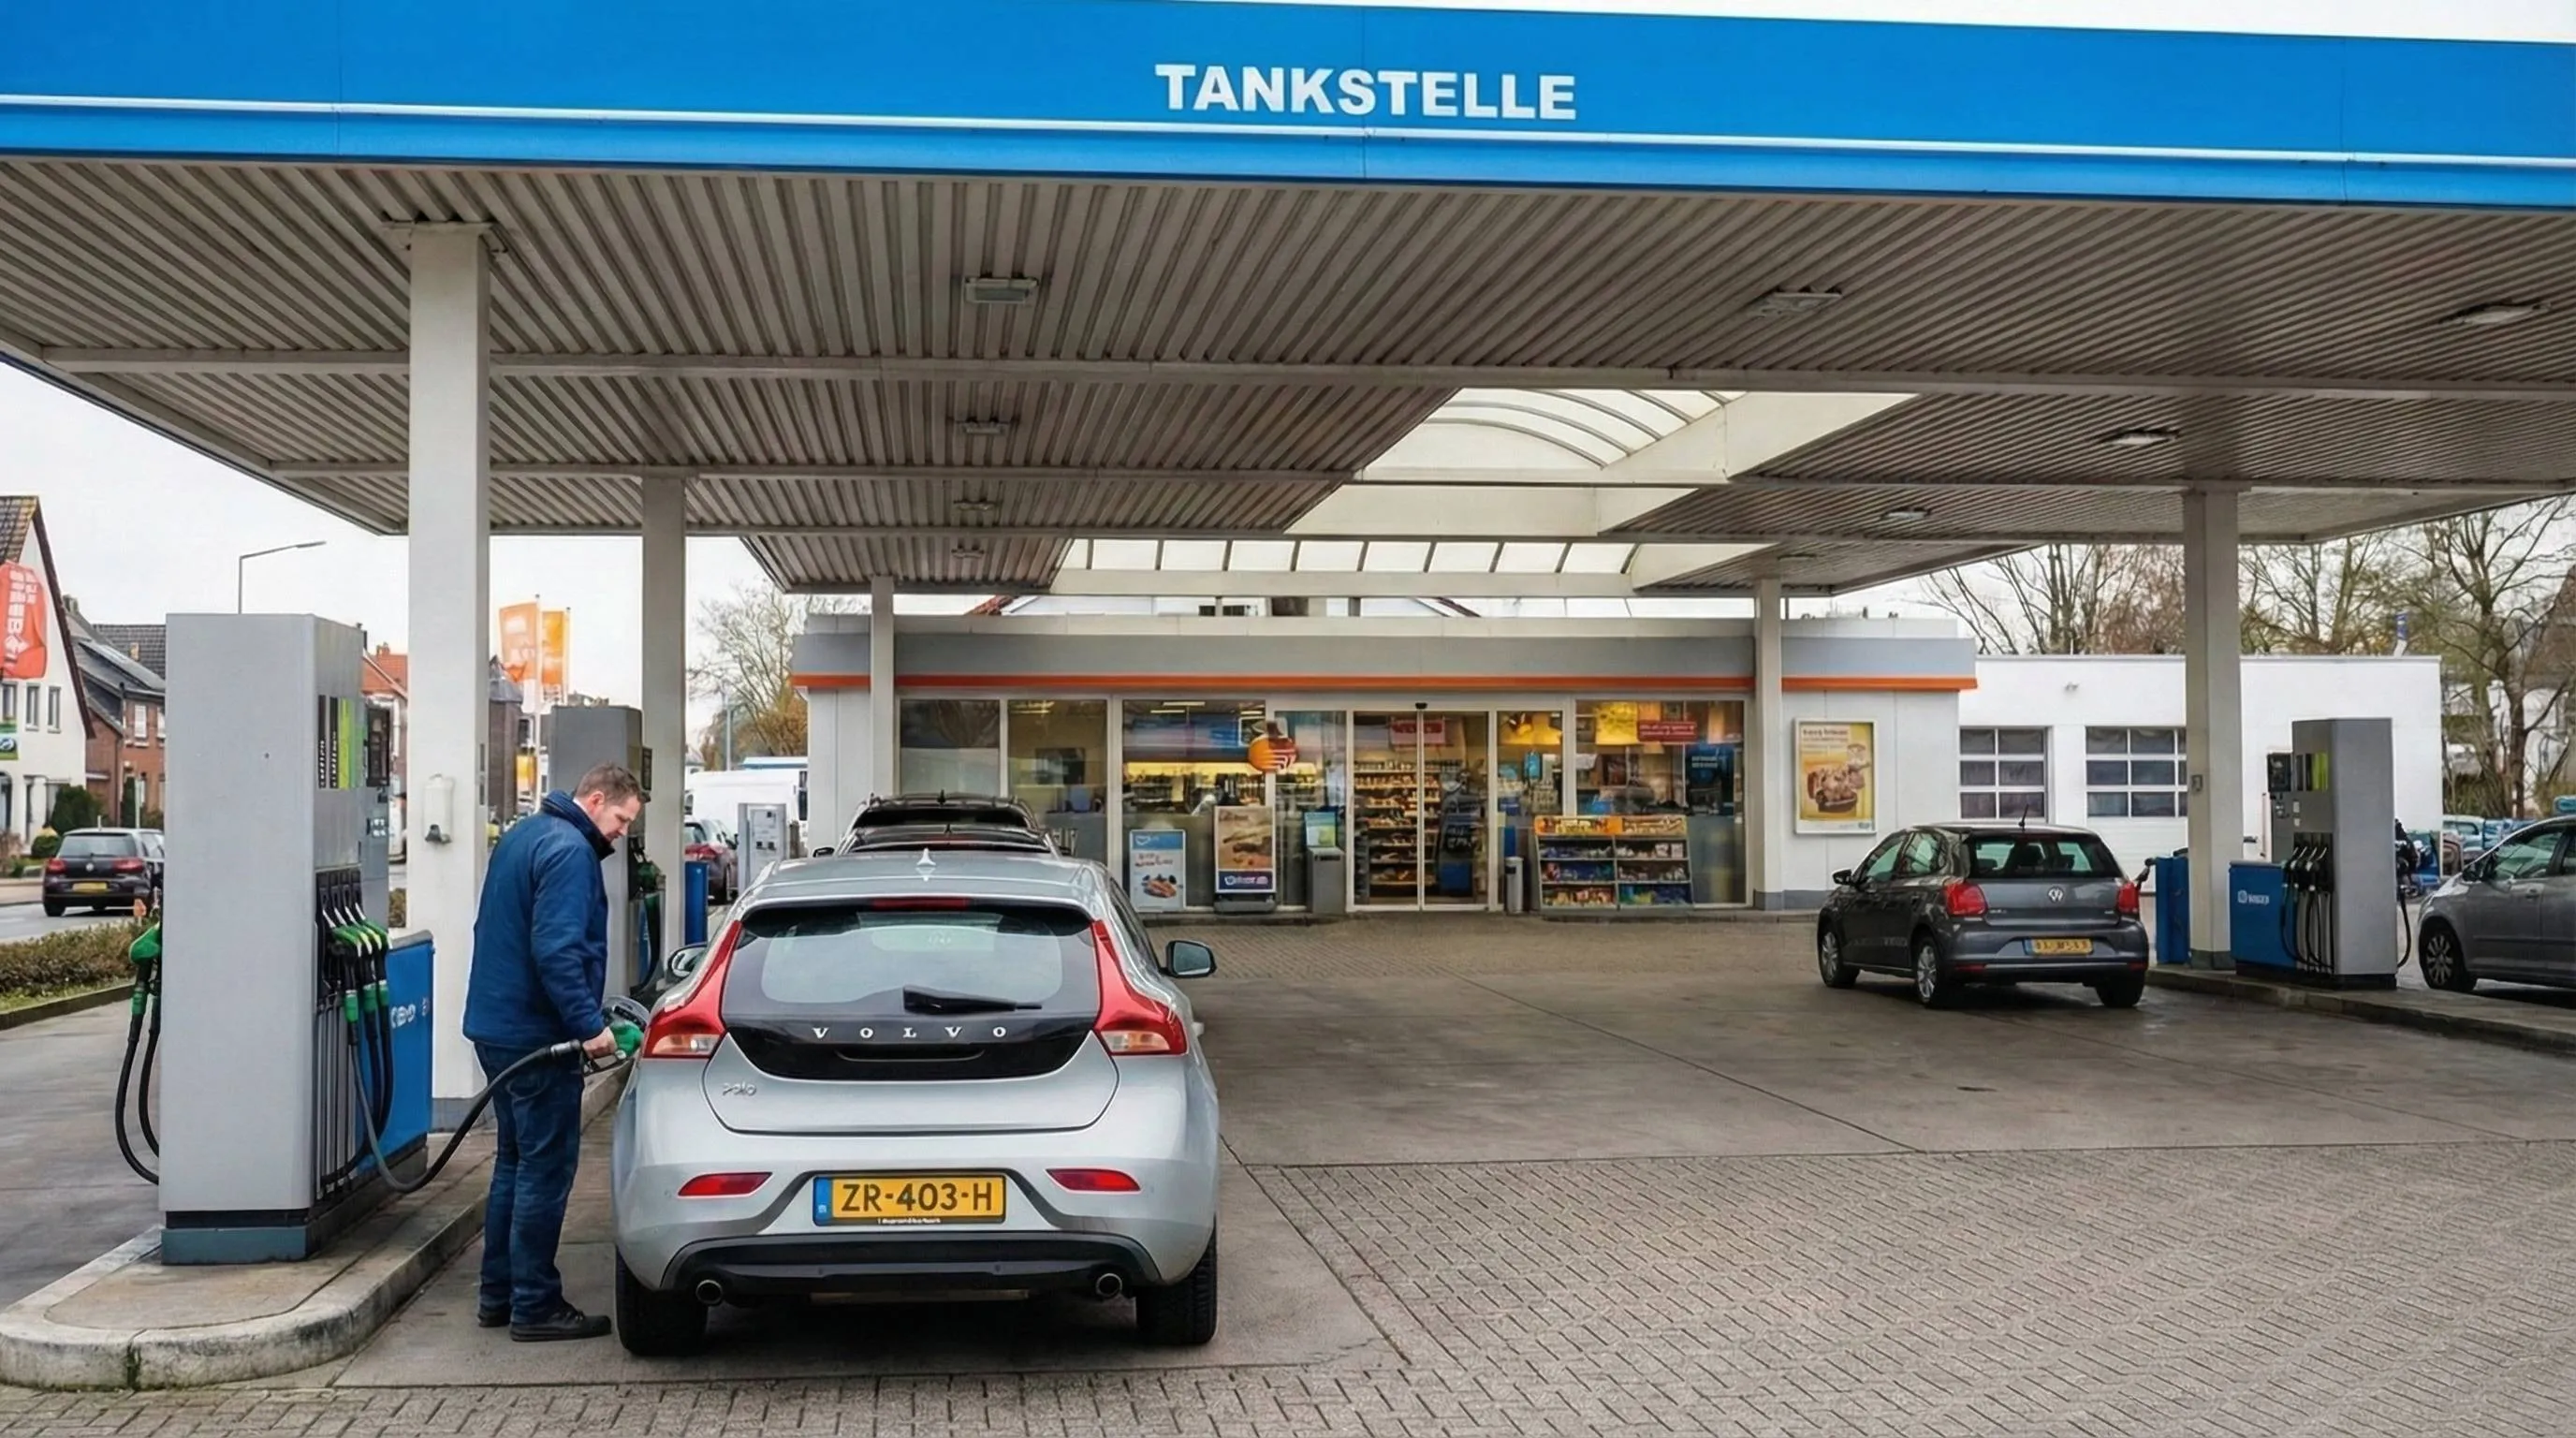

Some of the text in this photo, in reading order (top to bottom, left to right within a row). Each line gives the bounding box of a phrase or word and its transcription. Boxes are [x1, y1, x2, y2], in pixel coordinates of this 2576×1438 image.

[1155, 64, 1576, 120] TANKSTELLE
[812, 1026, 1007, 1039] VOLVO
[842, 1182, 992, 1212] ZR-403-H
